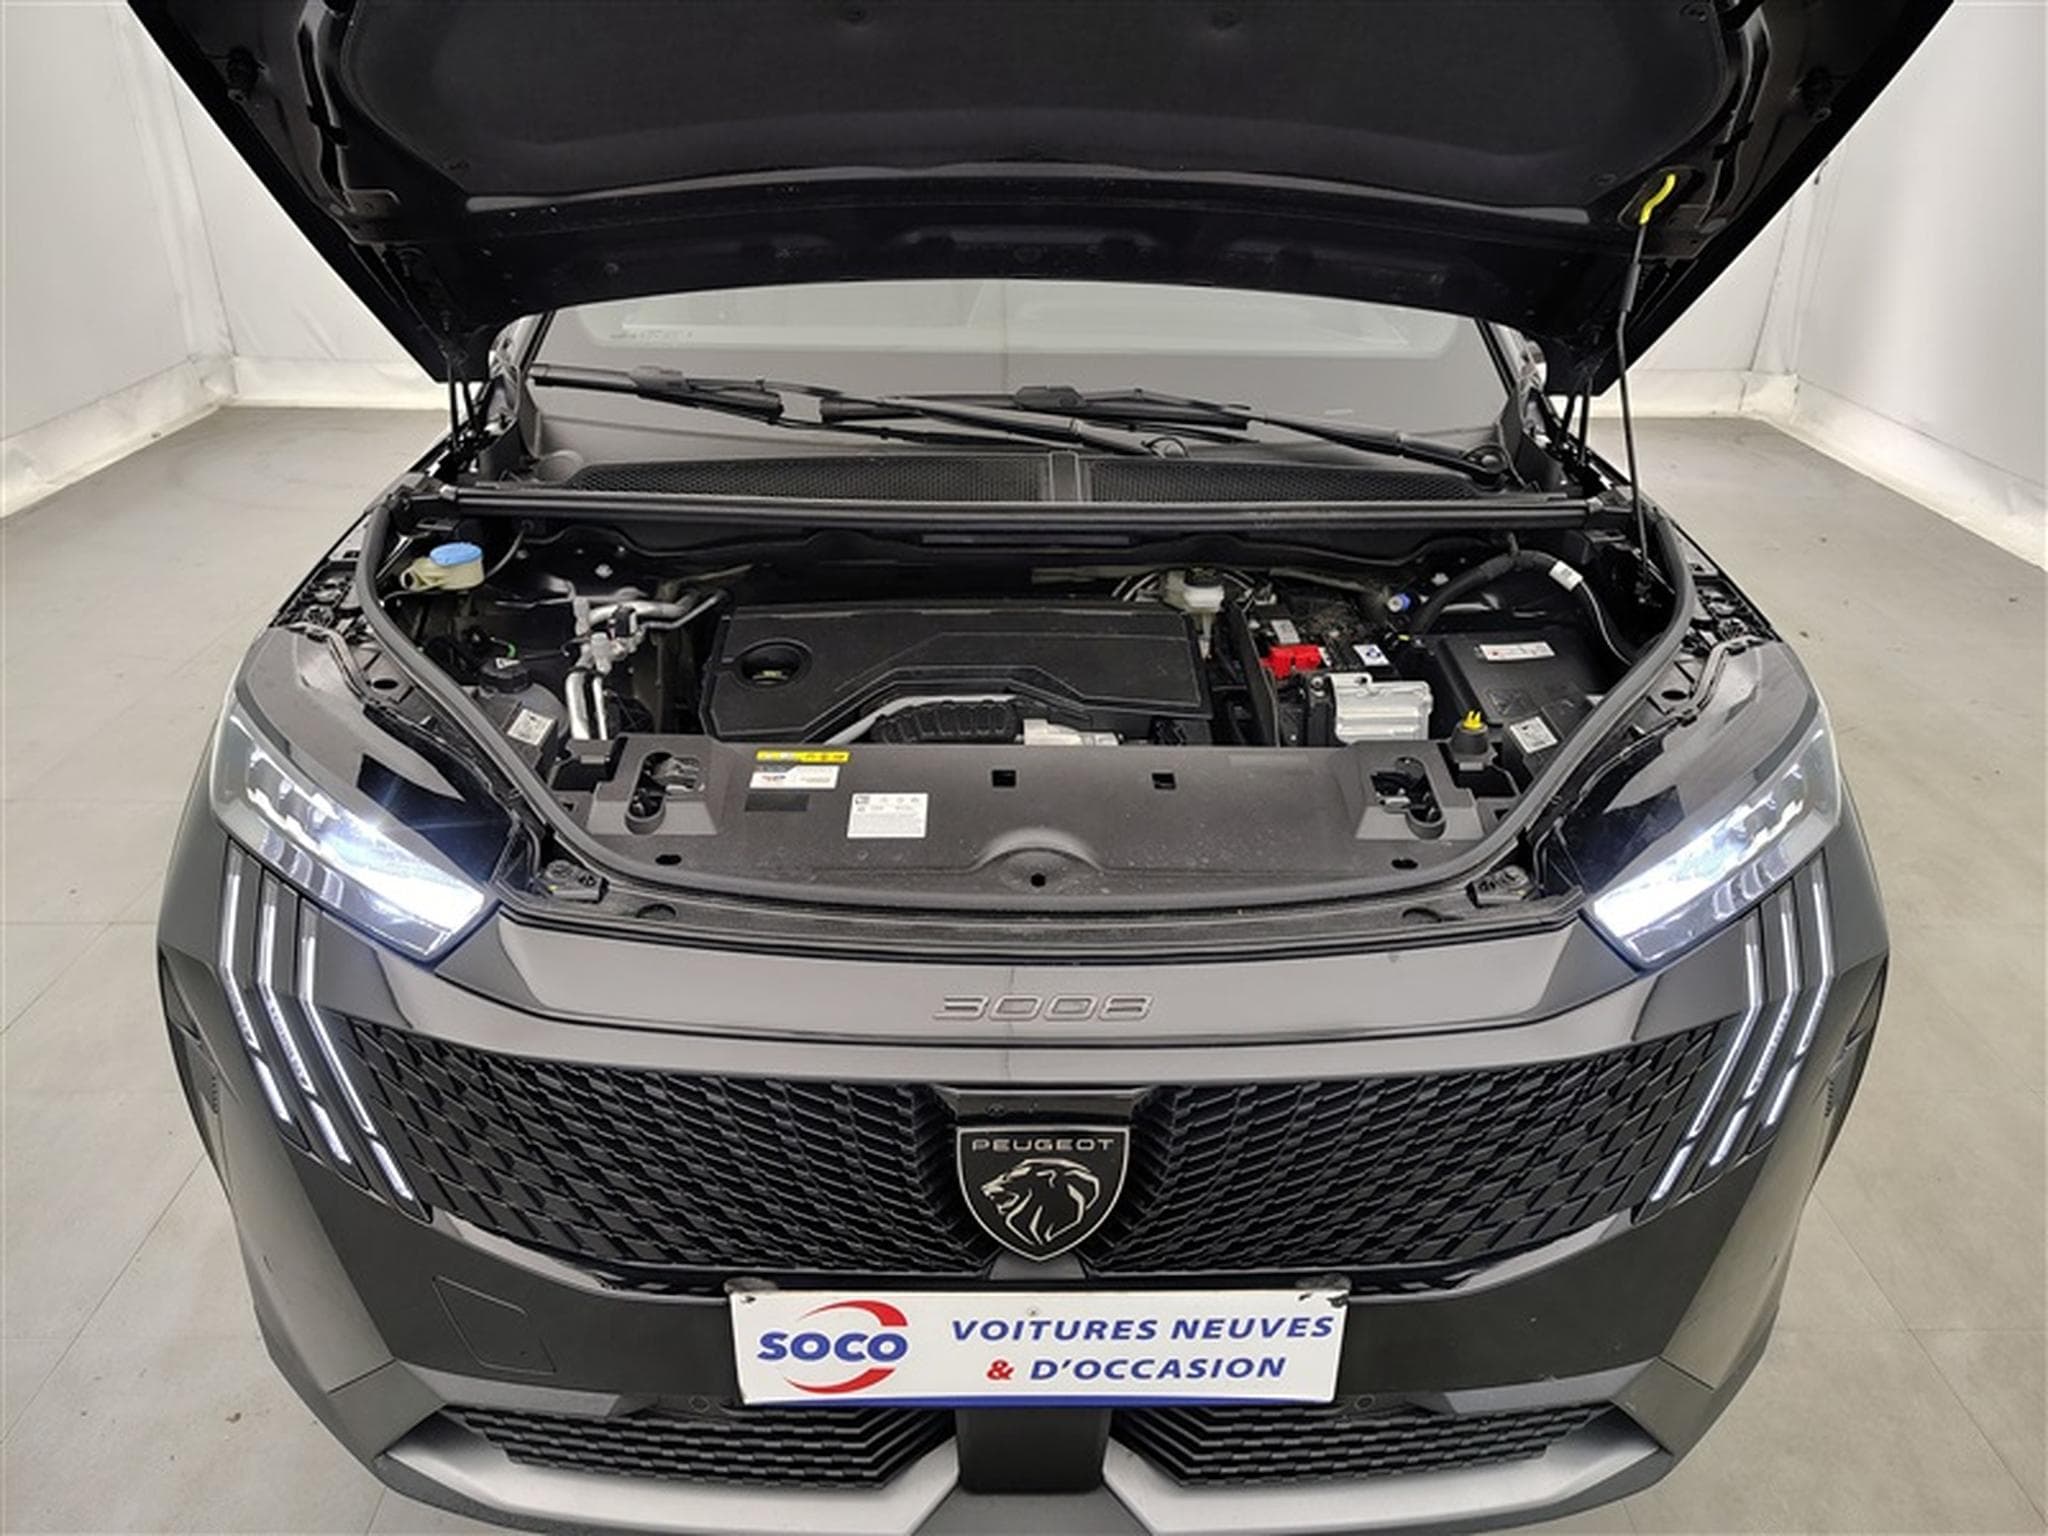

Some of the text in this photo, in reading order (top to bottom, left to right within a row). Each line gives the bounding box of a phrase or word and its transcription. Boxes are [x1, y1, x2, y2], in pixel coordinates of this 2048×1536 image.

[934, 994, 1152, 1021] 3008
[971, 1138, 1115, 1152] PEUGEOT
[952, 1316, 1334, 1341] VOITURES NEUVES
[758, 1330, 908, 1362] SOCO
[986, 1360, 1013, 1381] &
